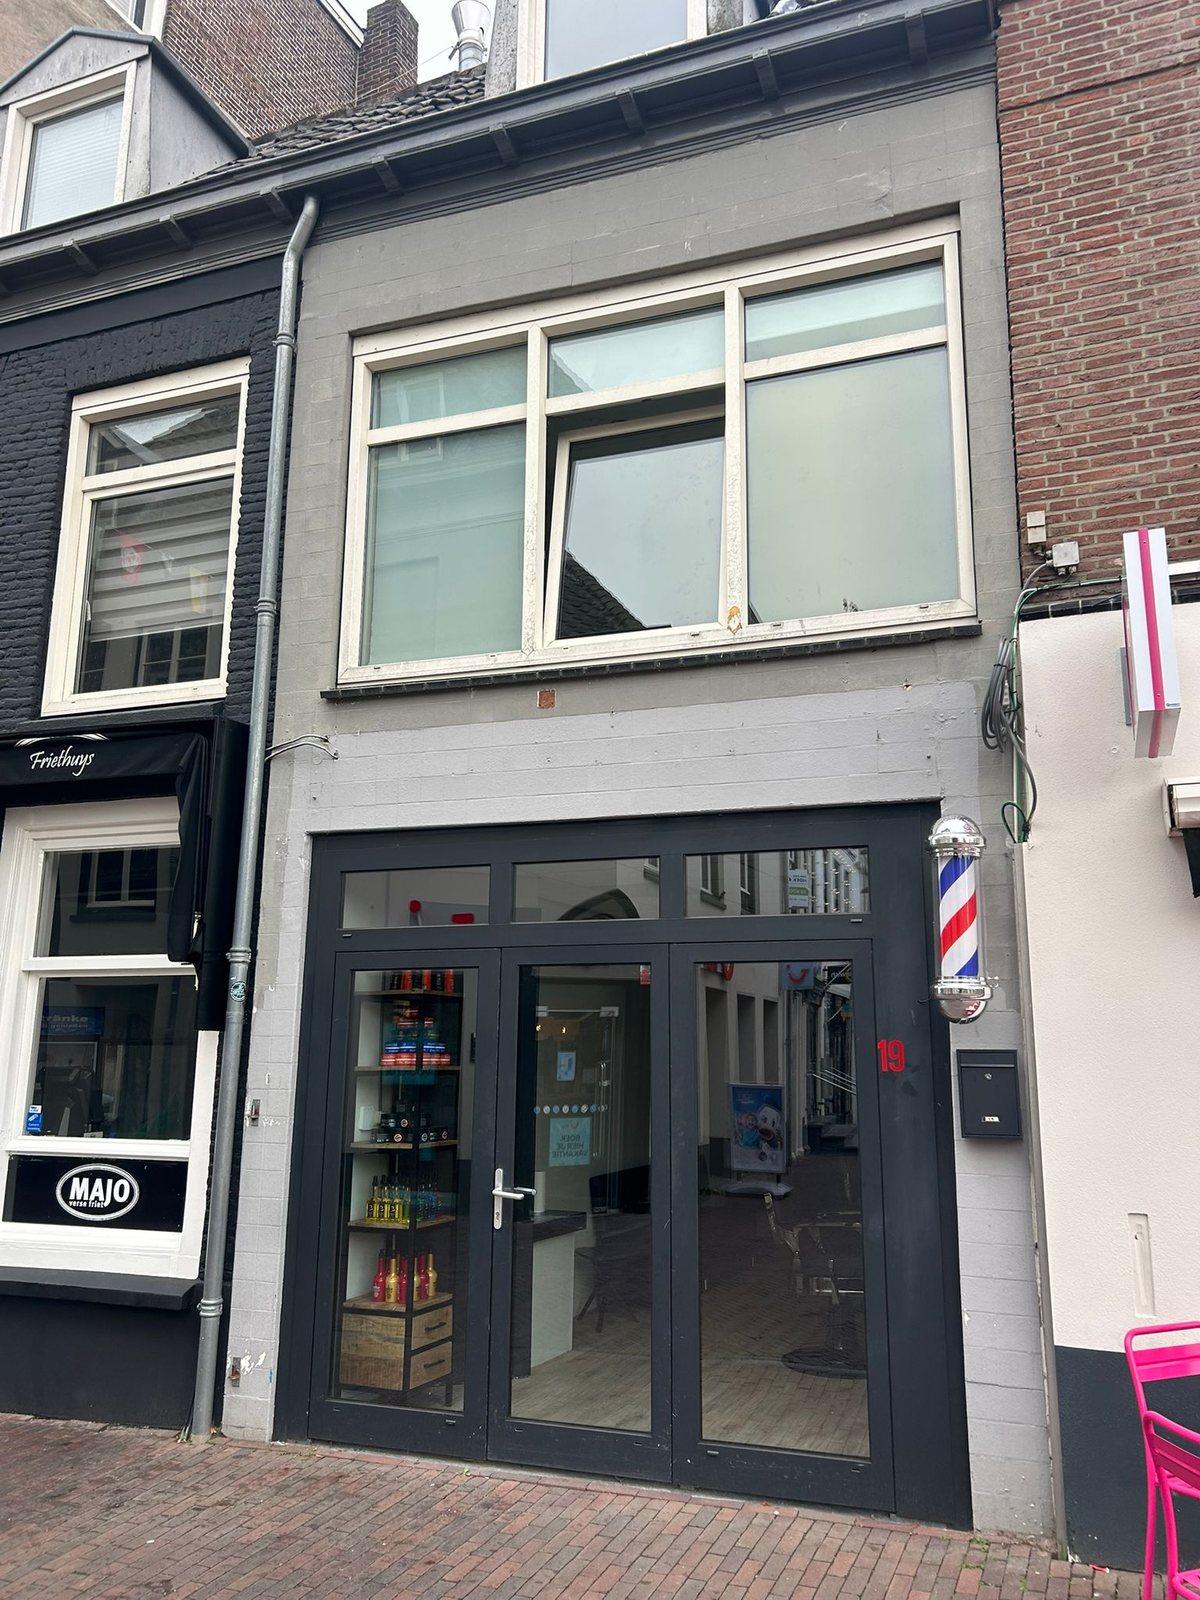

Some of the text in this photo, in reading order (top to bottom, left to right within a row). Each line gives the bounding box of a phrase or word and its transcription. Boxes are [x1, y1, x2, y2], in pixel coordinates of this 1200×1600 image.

[30, 745, 95, 776] Friethuys
[877, 1039, 905, 1072] 19
[69, 1177, 130, 1207] MAJO
